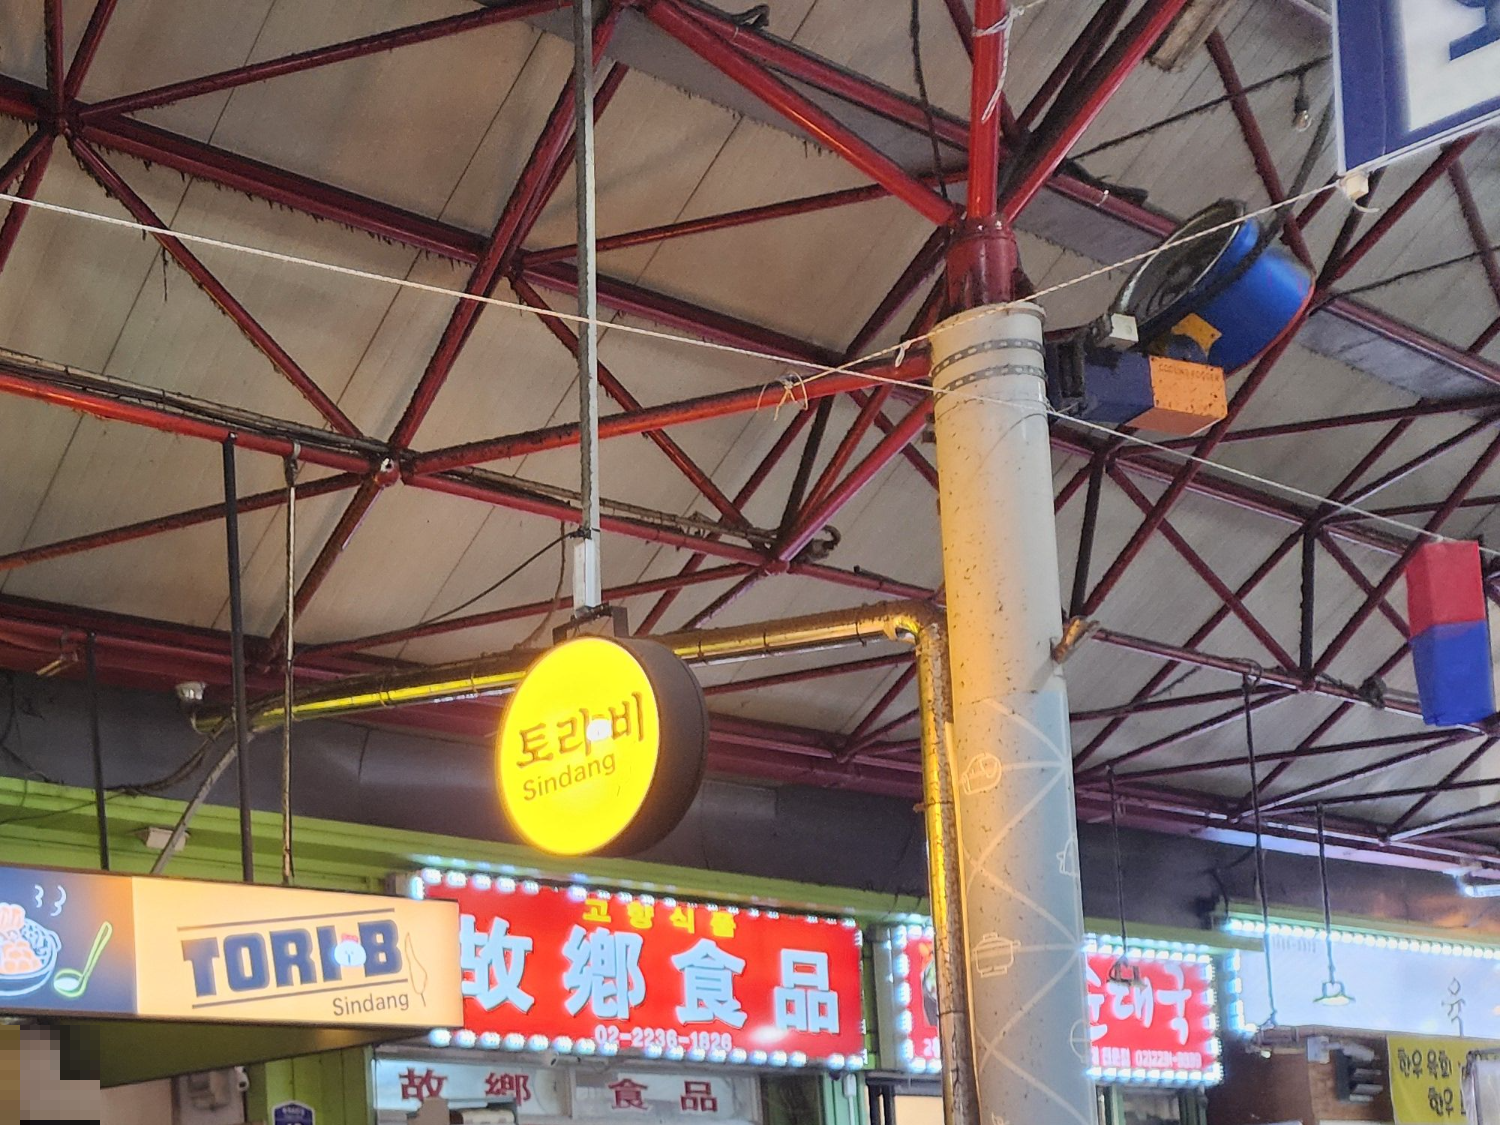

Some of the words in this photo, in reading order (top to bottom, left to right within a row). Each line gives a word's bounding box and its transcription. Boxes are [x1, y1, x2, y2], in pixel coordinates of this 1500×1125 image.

[522, 753, 617, 801] Sindang
[582, 898, 737, 938] 고향식품
[332, 990, 411, 1019] Sindang
